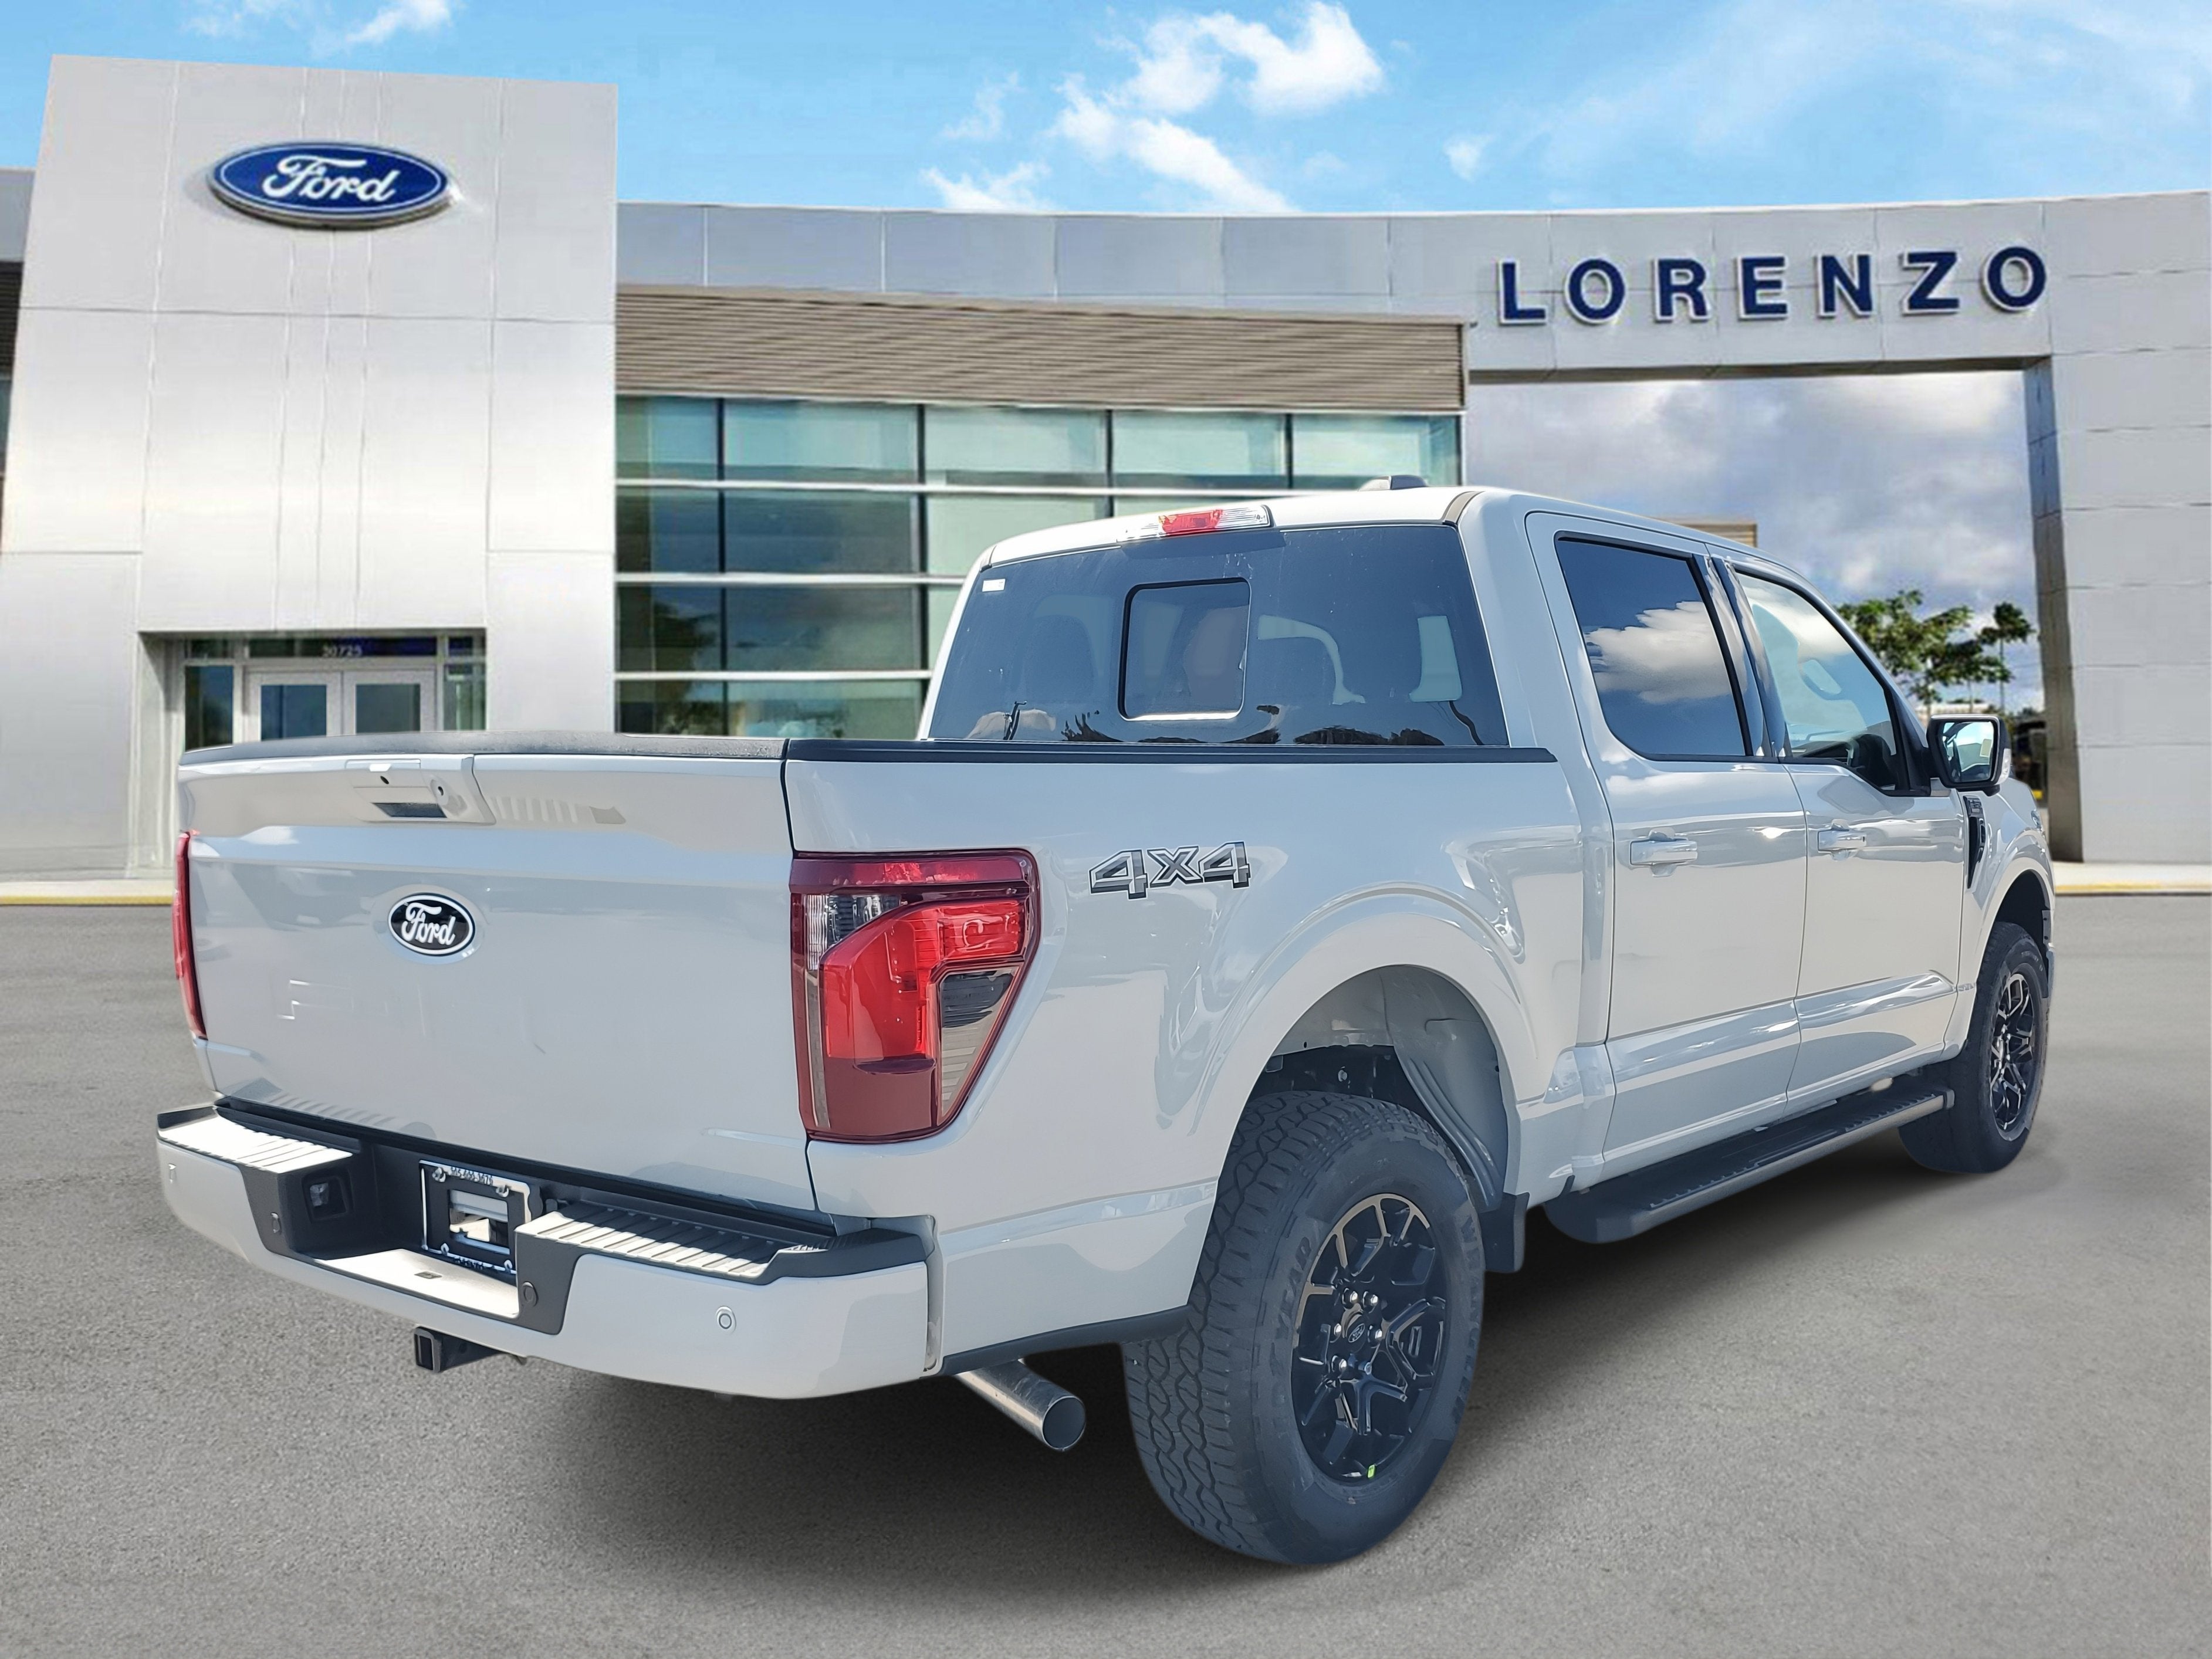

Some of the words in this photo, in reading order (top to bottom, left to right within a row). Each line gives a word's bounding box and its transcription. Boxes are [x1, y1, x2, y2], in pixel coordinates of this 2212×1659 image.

[262, 154, 400, 202] Ford
[1497, 246, 2047, 326] LORENZO
[401, 902, 456, 945] Ford
